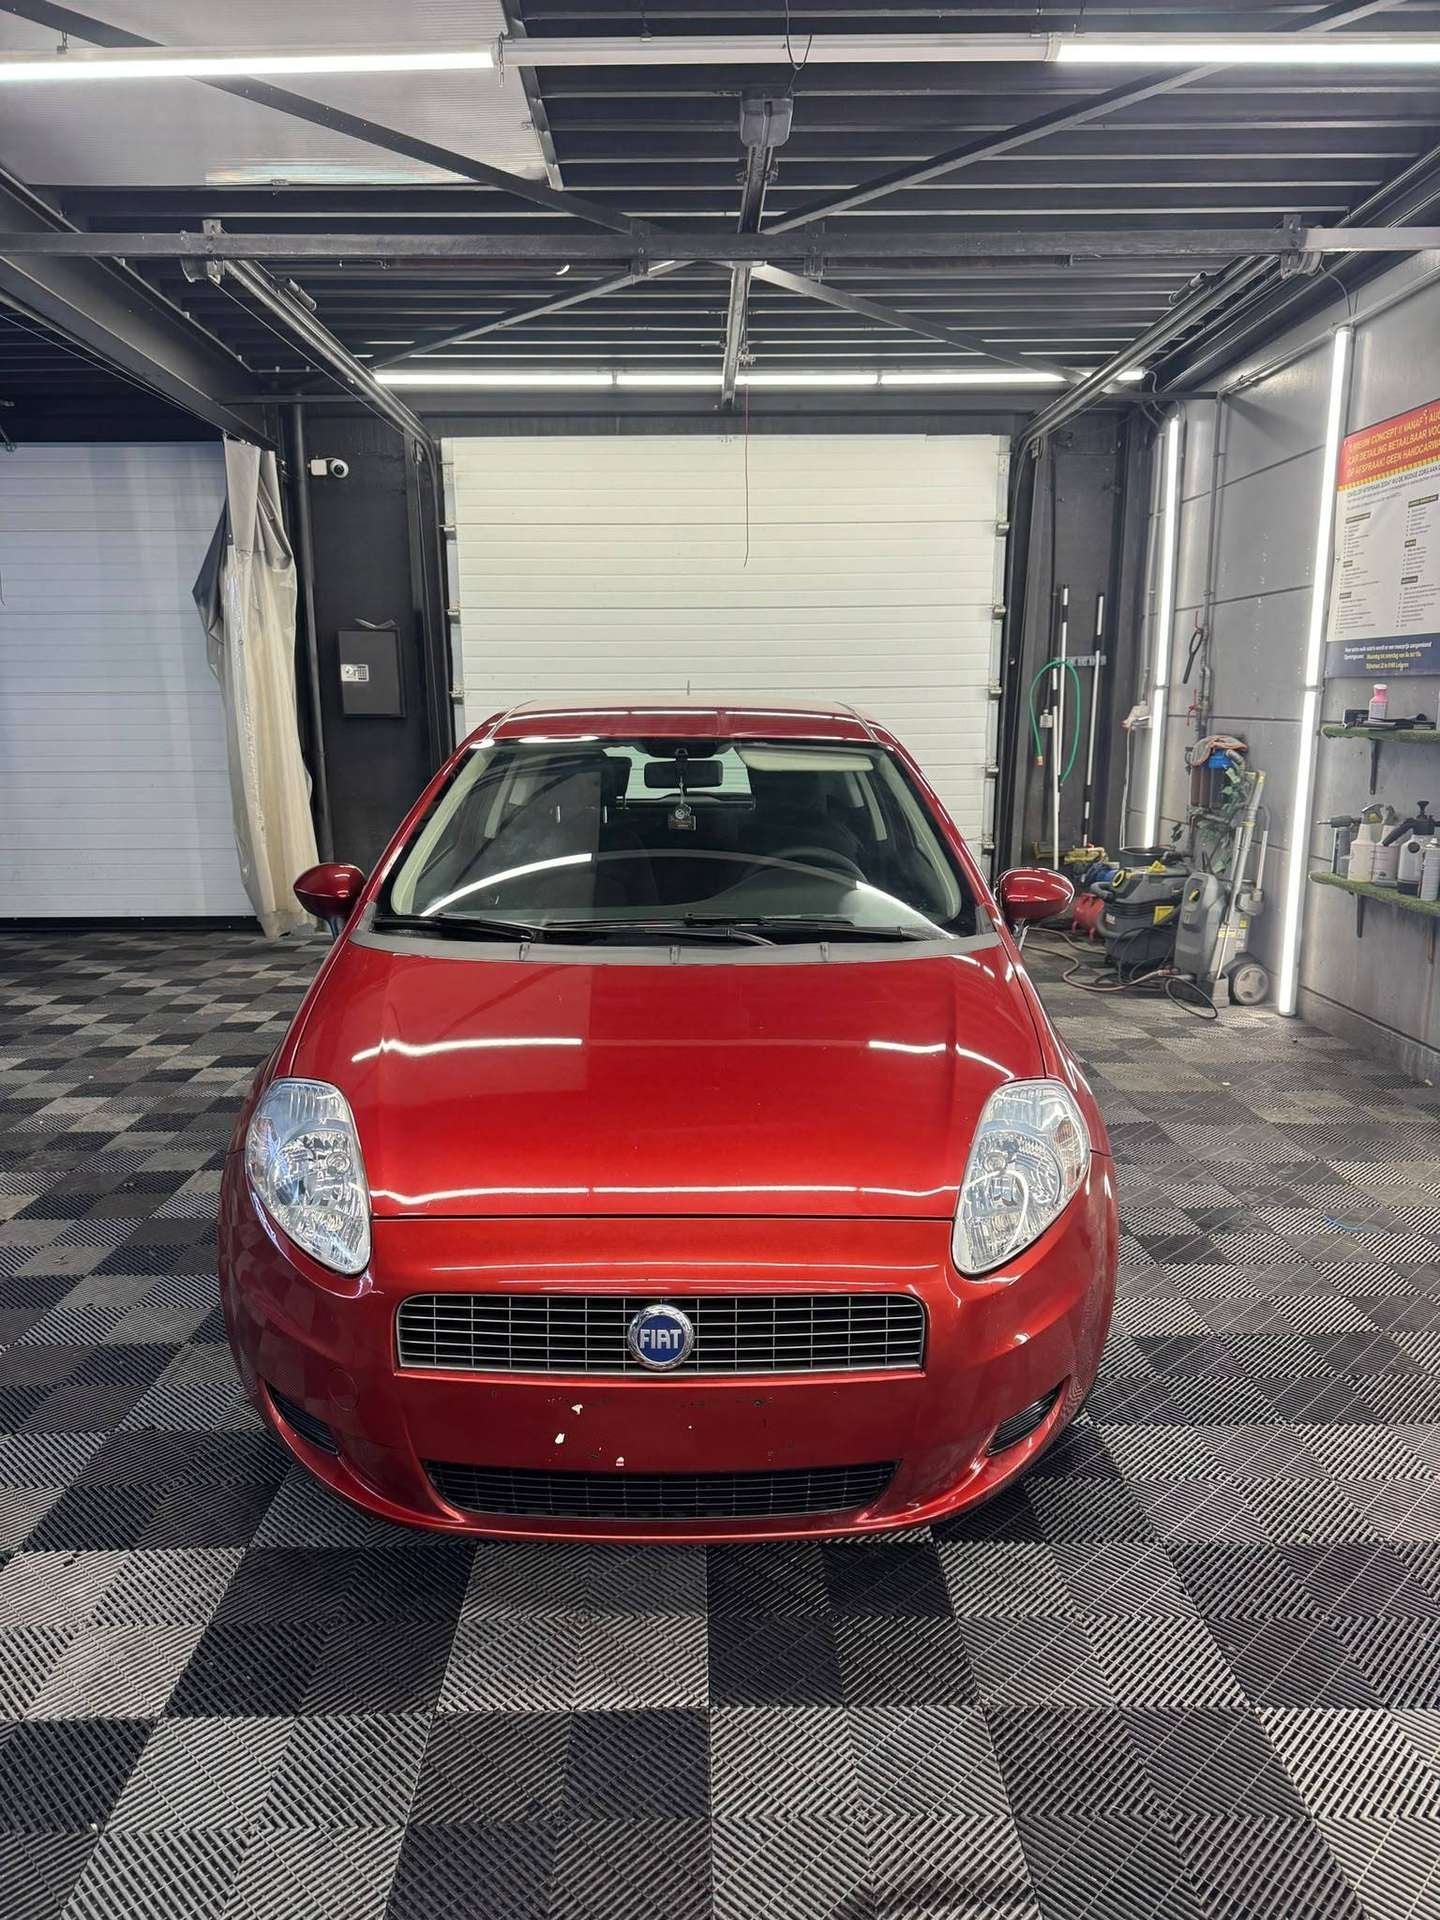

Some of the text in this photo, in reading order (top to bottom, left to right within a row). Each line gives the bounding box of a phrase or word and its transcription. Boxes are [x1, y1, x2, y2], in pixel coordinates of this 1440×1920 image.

[1370, 427, 1397, 445] CONCEPT
[1388, 428, 1428, 451] BETAALBAAR
[1385, 451, 1402, 466] GEEN
[639, 1328, 682, 1350] FIAT
